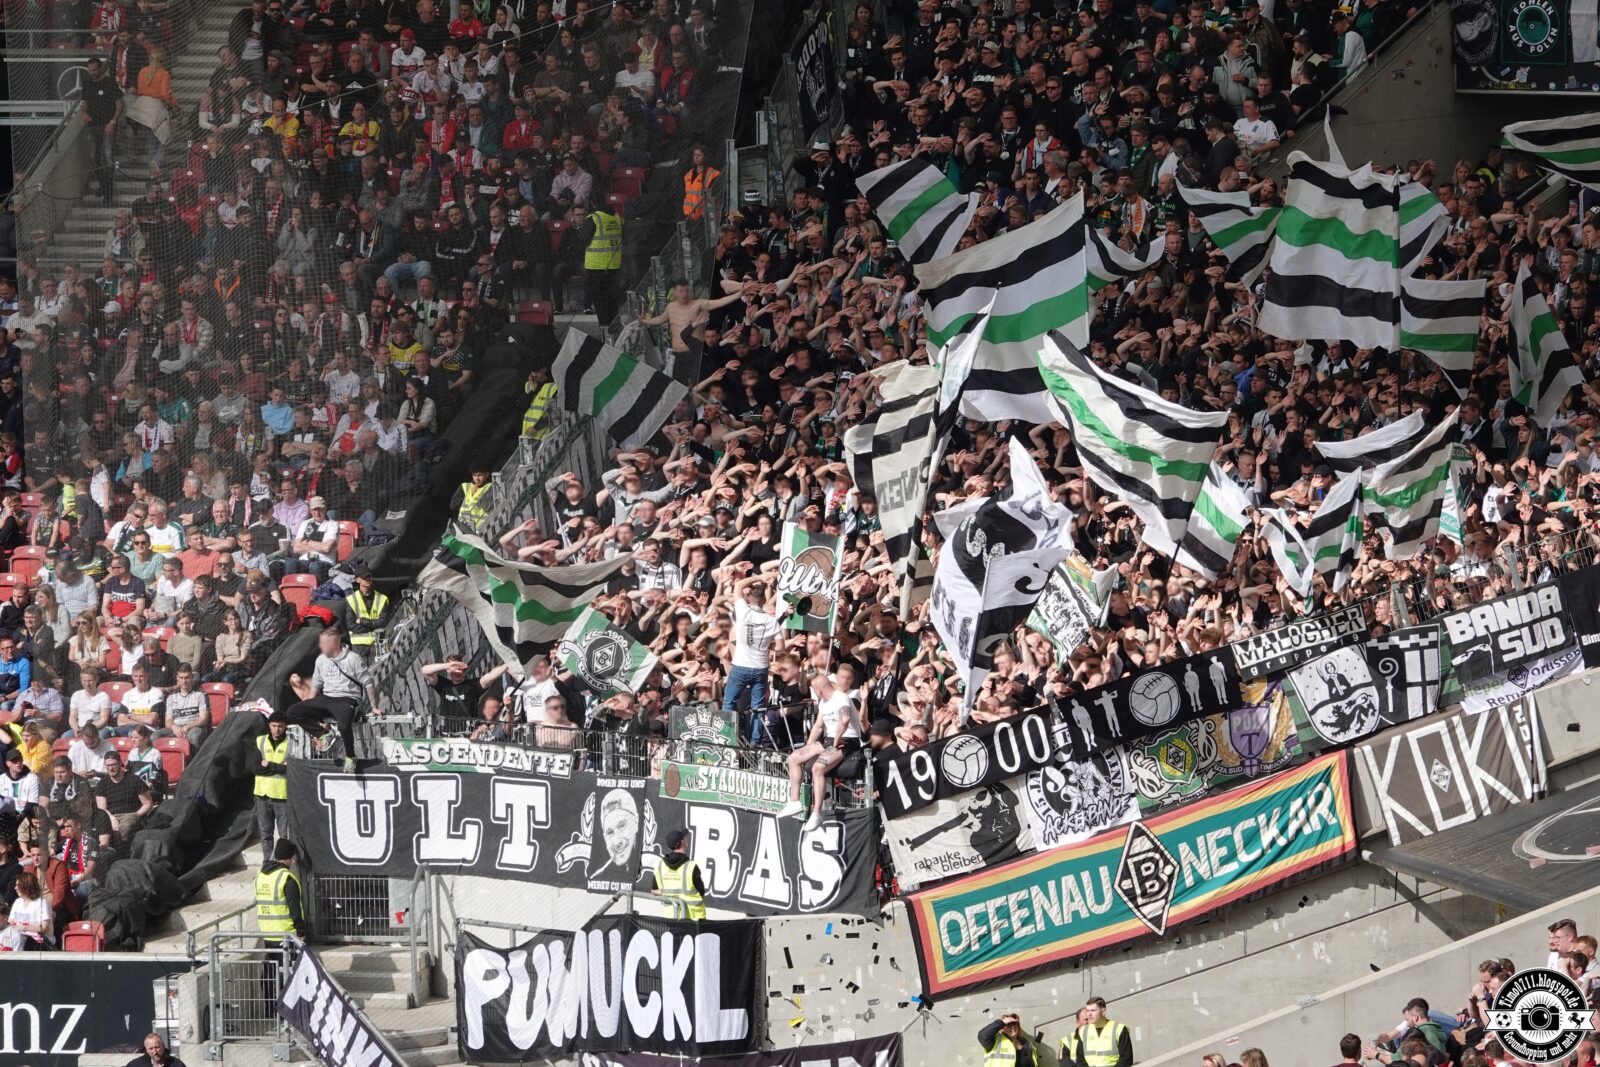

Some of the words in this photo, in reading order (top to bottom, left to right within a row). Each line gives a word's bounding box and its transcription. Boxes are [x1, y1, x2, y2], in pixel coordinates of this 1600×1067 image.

[1513, 0, 1554, 15] FOHLEN
[1509, 24, 1523, 48] AUS
[1530, 27, 1559, 53] POLEN
[1443, 585, 1563, 645] BANDA
[1498, 617, 1566, 662] SUD
[1250, 645, 1327, 676] gruppe
[696, 728, 715, 737] NORD
[389, 742, 573, 779] ASCENDENTE
[887, 751, 937, 810] 19
[994, 714, 1050, 774] 00
[596, 778, 617, 788] IMMER
[698, 766, 792, 803] STADIONVERBO
[1043, 792, 1132, 845] ACKERBANDE
[914, 851, 961, 871] rabauke
[938, 864, 1114, 957] OFFENAU
[1177, 782, 1338, 888] NECKAR
[941, 854, 983, 872] bleiben
[463, 929, 749, 1050] PUMUCKL
